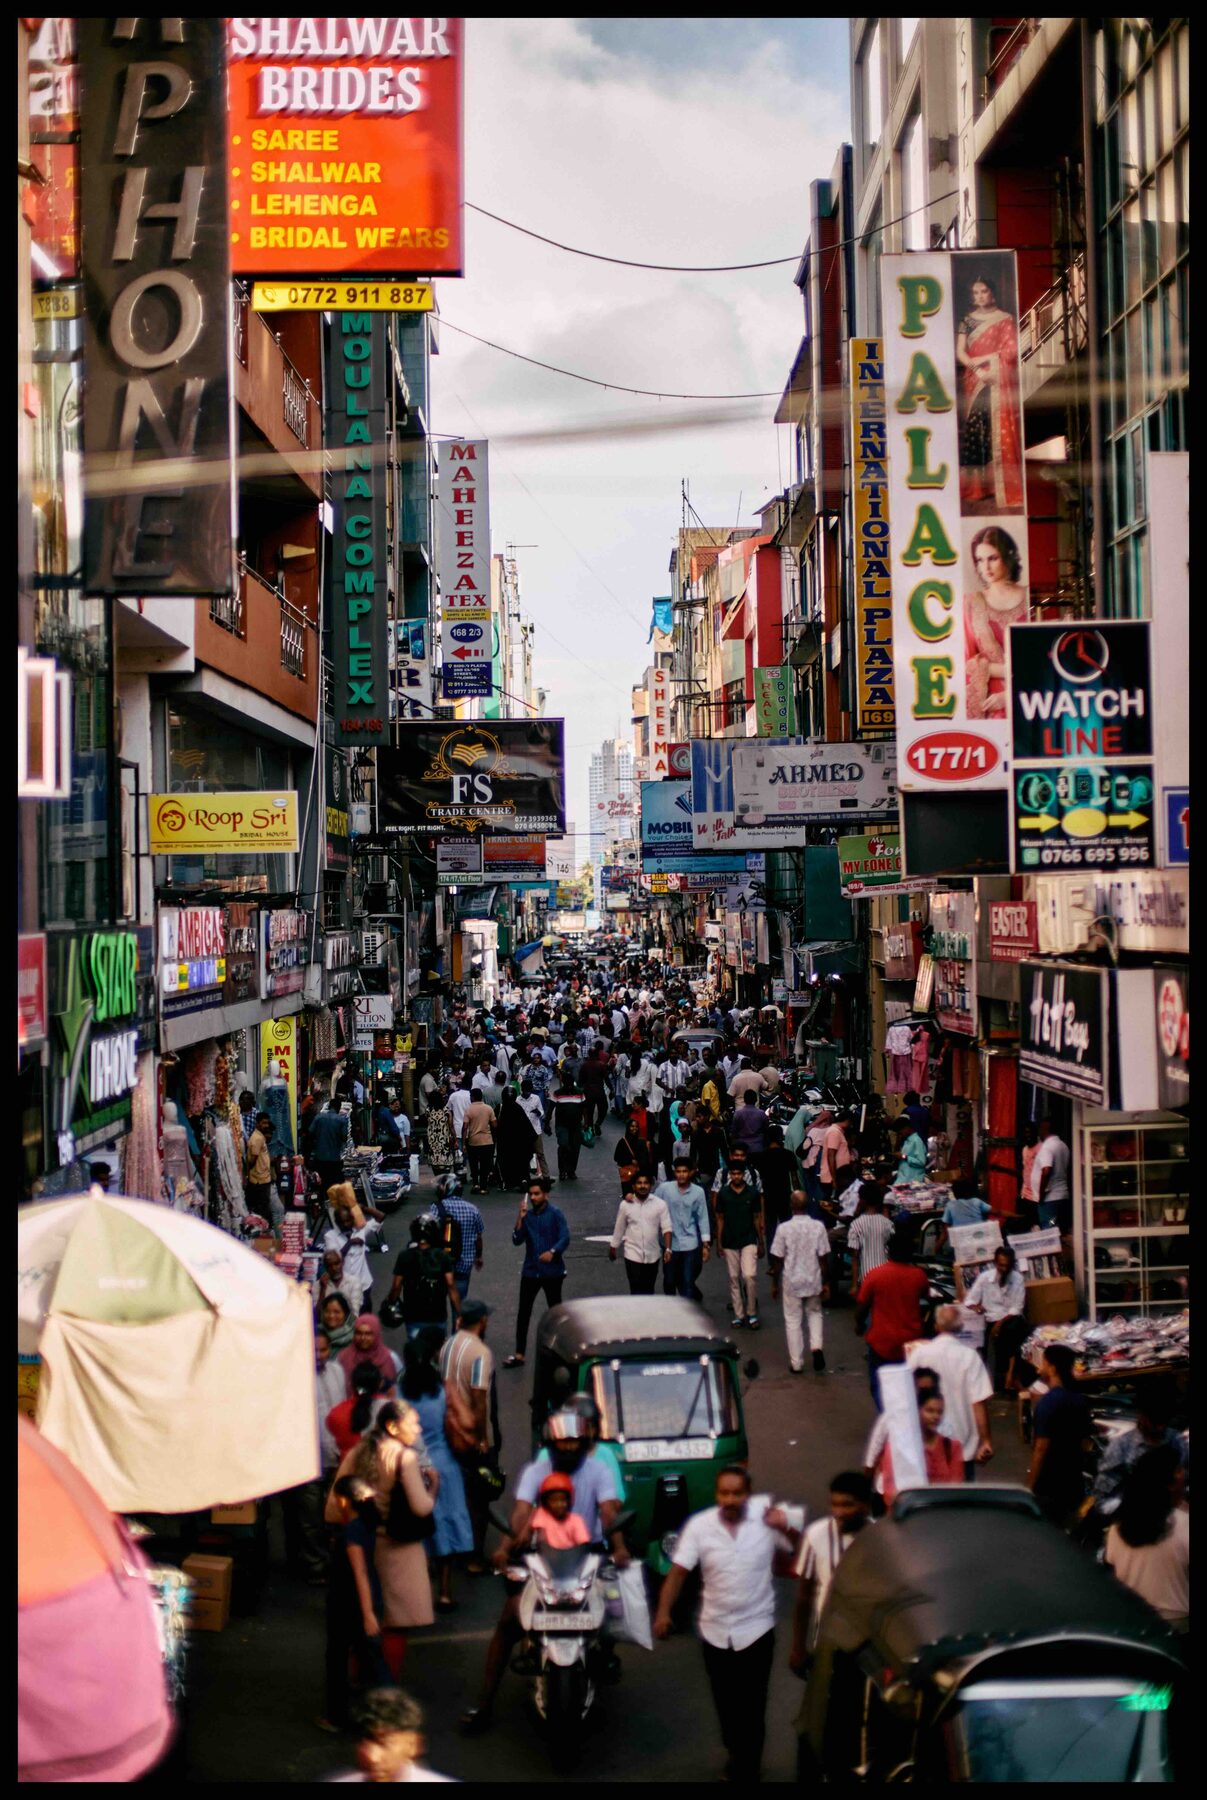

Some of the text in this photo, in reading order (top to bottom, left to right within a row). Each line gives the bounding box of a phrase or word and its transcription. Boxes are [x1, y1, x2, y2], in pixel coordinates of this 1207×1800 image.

[231, 18, 450, 57] SHALWAR
[259, 65, 422, 112] BRIDES
[251, 129, 339, 151] SAREE
[251, 162, 382, 183] SHALWAR
[251, 194, 378, 216] LEHENGA
[250, 227, 450, 249] BRIDAL WEARS
[110, 18, 208, 578] PHONE
[287, 285, 427, 305] 0772 911 887
[341, 312, 376, 705] MOULANA COMPLEX
[895, 275, 959, 721] PALACE
[449, 444, 478, 591] MAHEEZA
[858, 342, 894, 706] INTERNATIONAL PLAZA
[445, 594, 488, 607] TEX
[451, 628, 482, 637] 168 2/3
[1019, 689, 1144, 720] WATCH
[654, 670, 668, 772] SHEEMA
[1043, 726, 1123, 755] LINE
[911, 745, 987, 770] 177/1
[768, 762, 865, 784] AHMED
[449, 773, 494, 805] FS
[188, 808, 287, 833] Roop Sri
[431, 807, 512, 816] TRADE CENTRE
[440, 836, 477, 844] Centre
[715, 826, 737, 841] Talk
[843, 861, 861, 873] MY
[863, 859, 892, 872] FONE
[1041, 847, 1149, 864] 0766 695 996
[991, 906, 1029, 937] EASTER
[90, 931, 137, 1023] STAR
